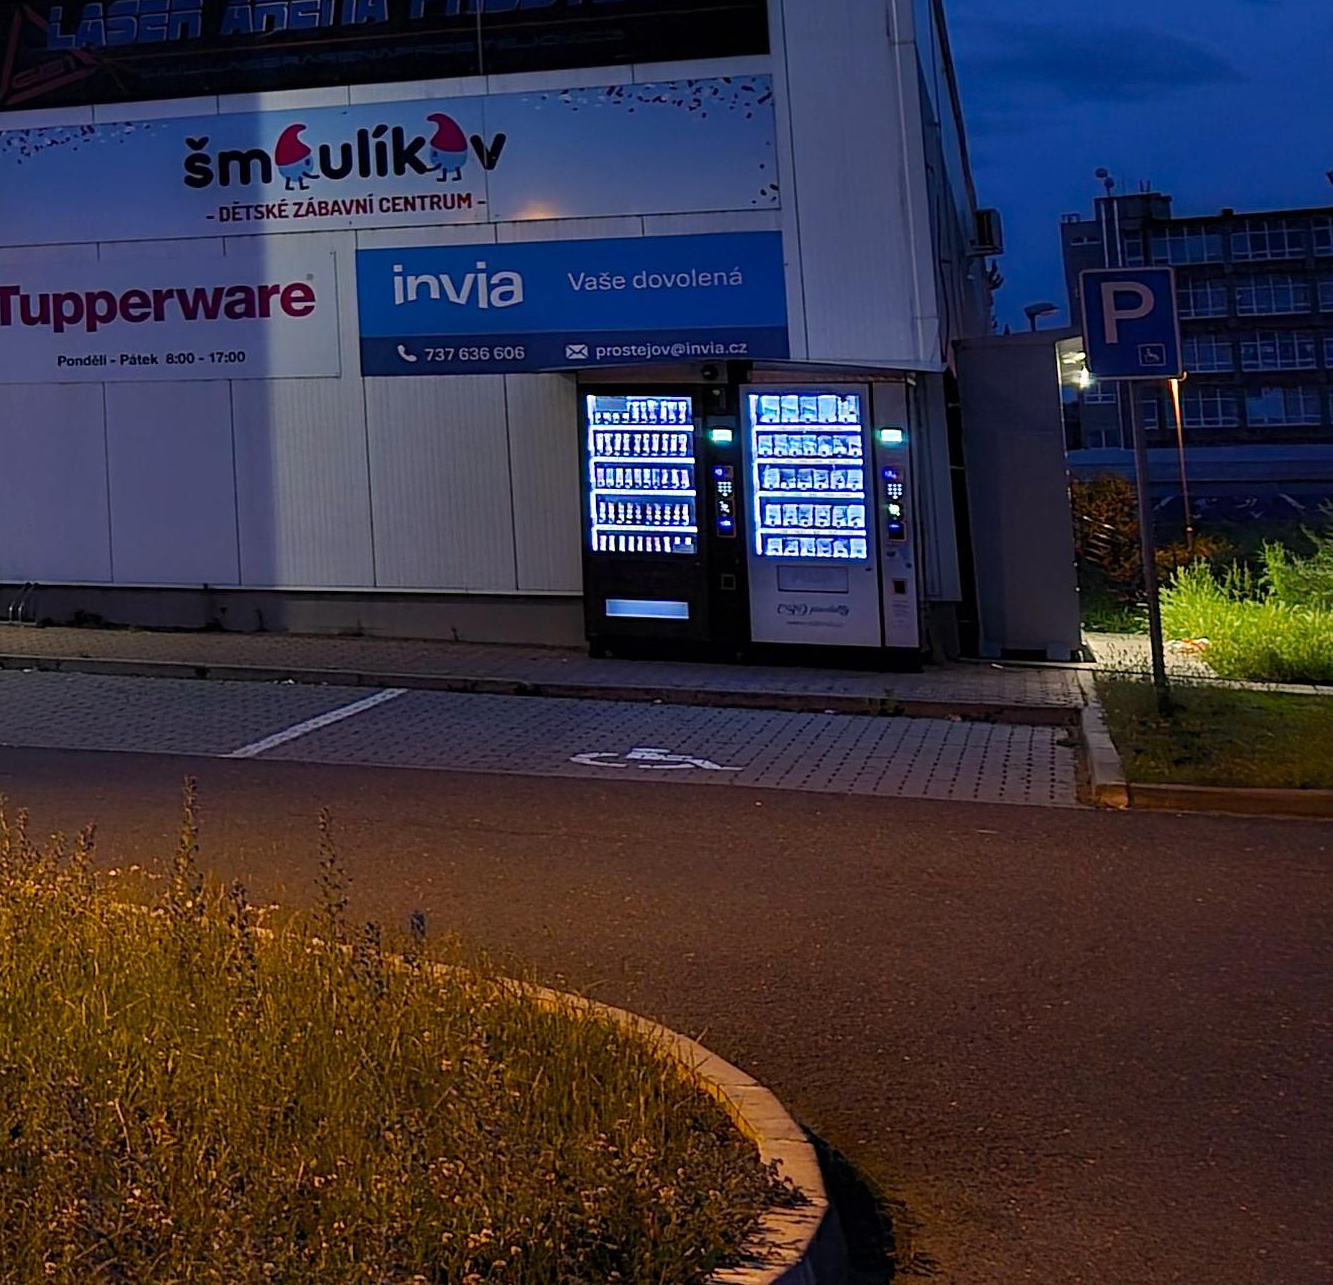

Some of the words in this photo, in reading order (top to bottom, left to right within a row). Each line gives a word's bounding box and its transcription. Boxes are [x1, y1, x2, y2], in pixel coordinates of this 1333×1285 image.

[219, 200, 289, 222] DĚTSKÉ
[293, 194, 373, 217] ZÁBAVNÍ
[379, 193, 472, 214] CENTRUM
[393, 261, 524, 309] invia
[567, 272, 626, 291] Vaše
[633, 267, 743, 289] dovolená
[1101, 282, 1154, 344] P
[58, 354, 107, 366] Pondělí
[120, 353, 158, 366] Pátek
[166, 352, 195, 365] 8:00
[209, 351, 246, 363] 17:00
[424, 347, 456, 361] 737
[459, 347, 489, 360] 636
[493, 346, 525, 360] 606
[595, 341, 748, 359] prostejov@invia.cz
